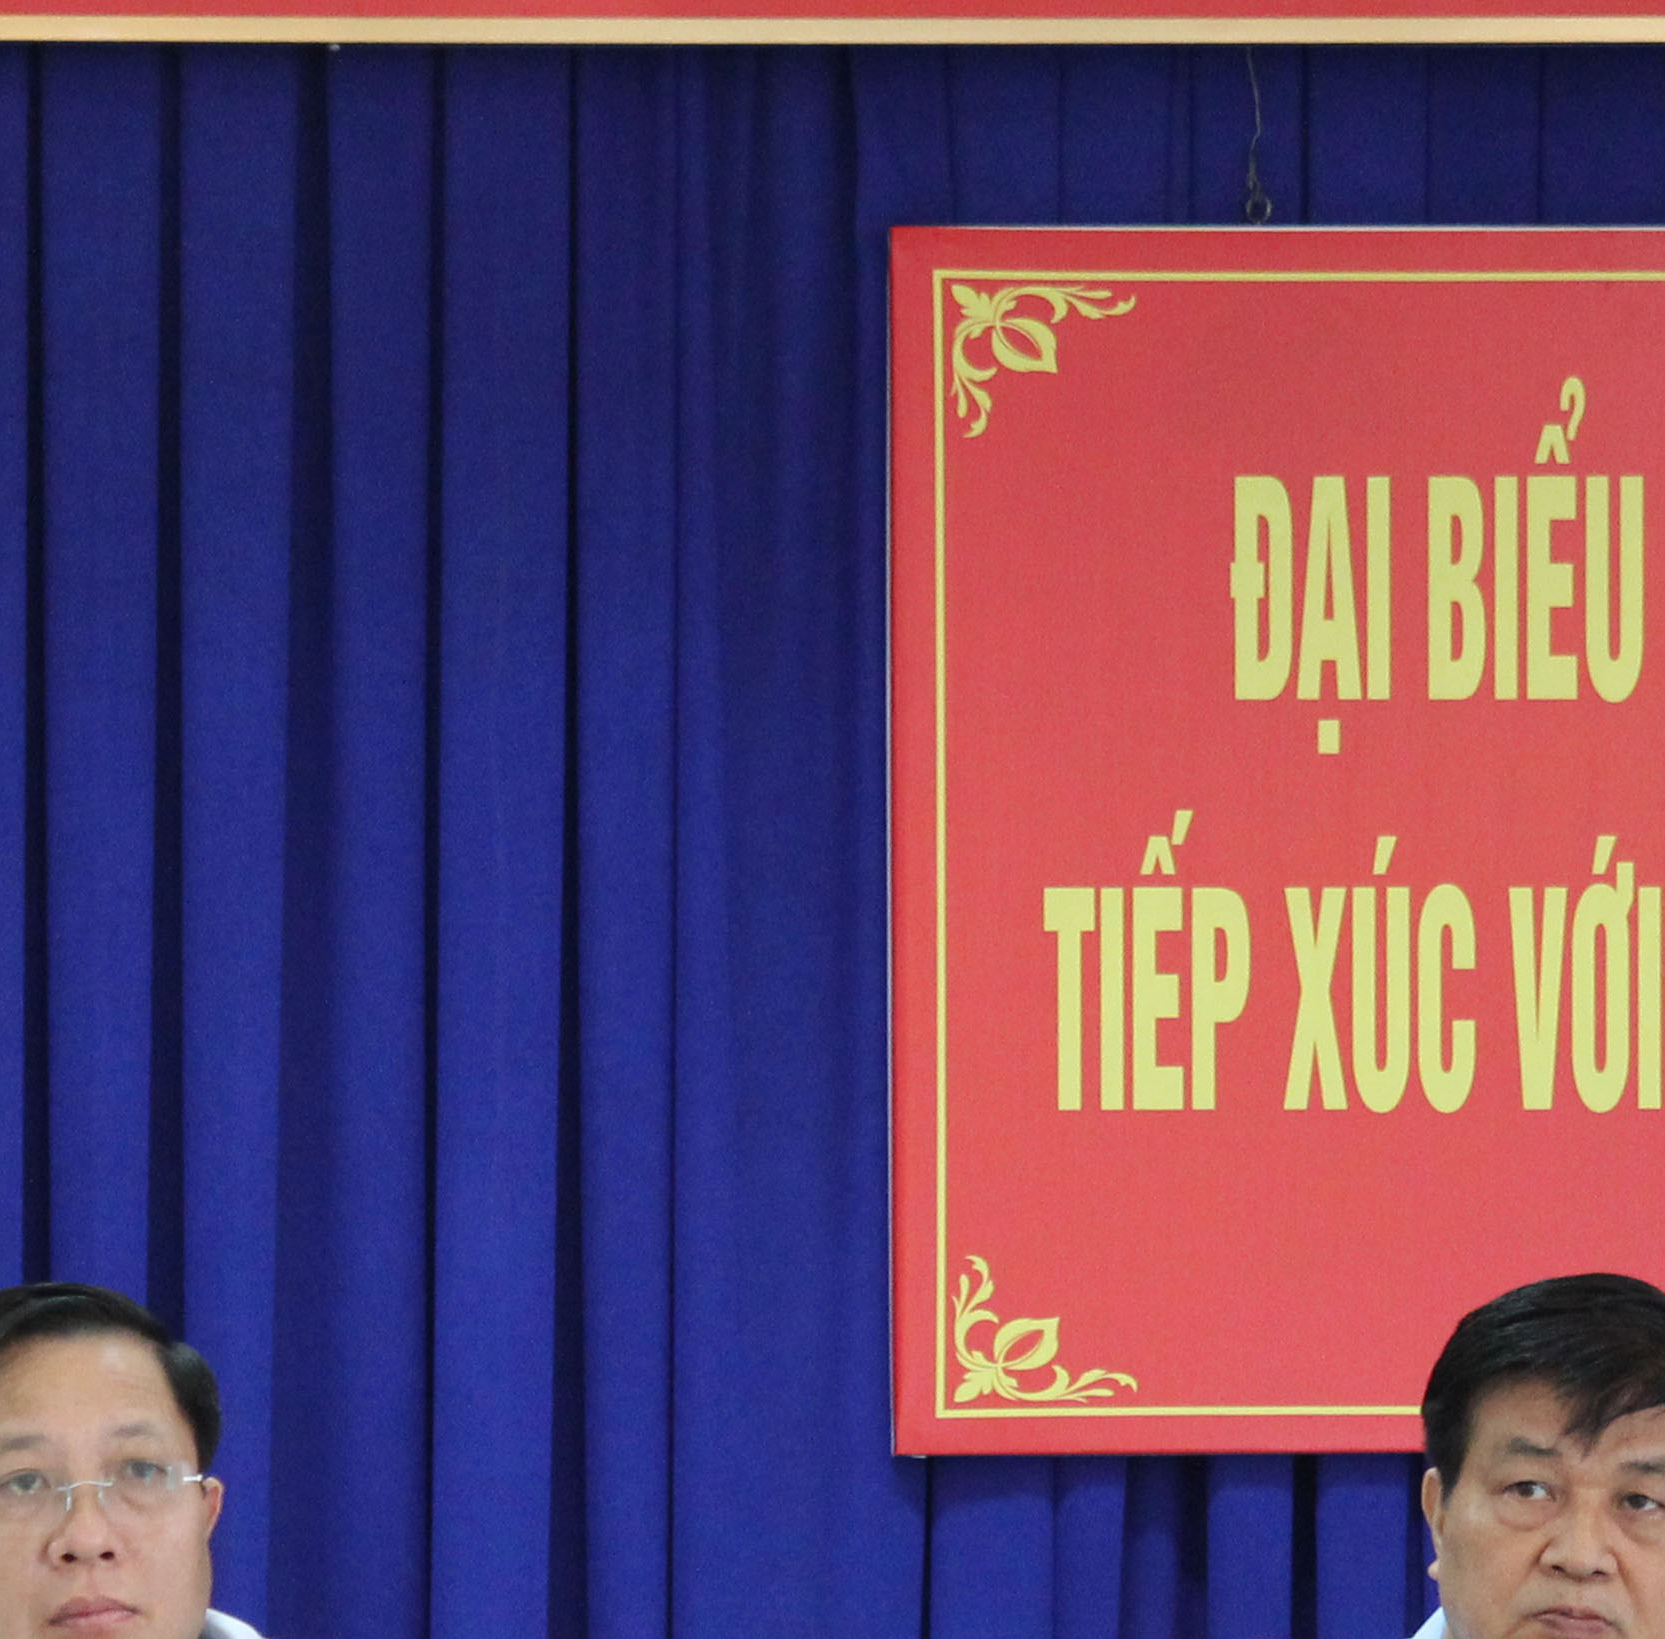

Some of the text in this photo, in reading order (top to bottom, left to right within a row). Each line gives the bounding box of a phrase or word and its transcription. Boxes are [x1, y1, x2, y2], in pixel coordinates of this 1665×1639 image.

[1229, 474, 1393, 756] ĐẠI
[1427, 376, 1646, 704] BIỂU
[1042, 808, 1252, 1112] TIẾP
[1282, 834, 1478, 1114] XÚC
[1507, 833, 1664, 1114] VỚI
